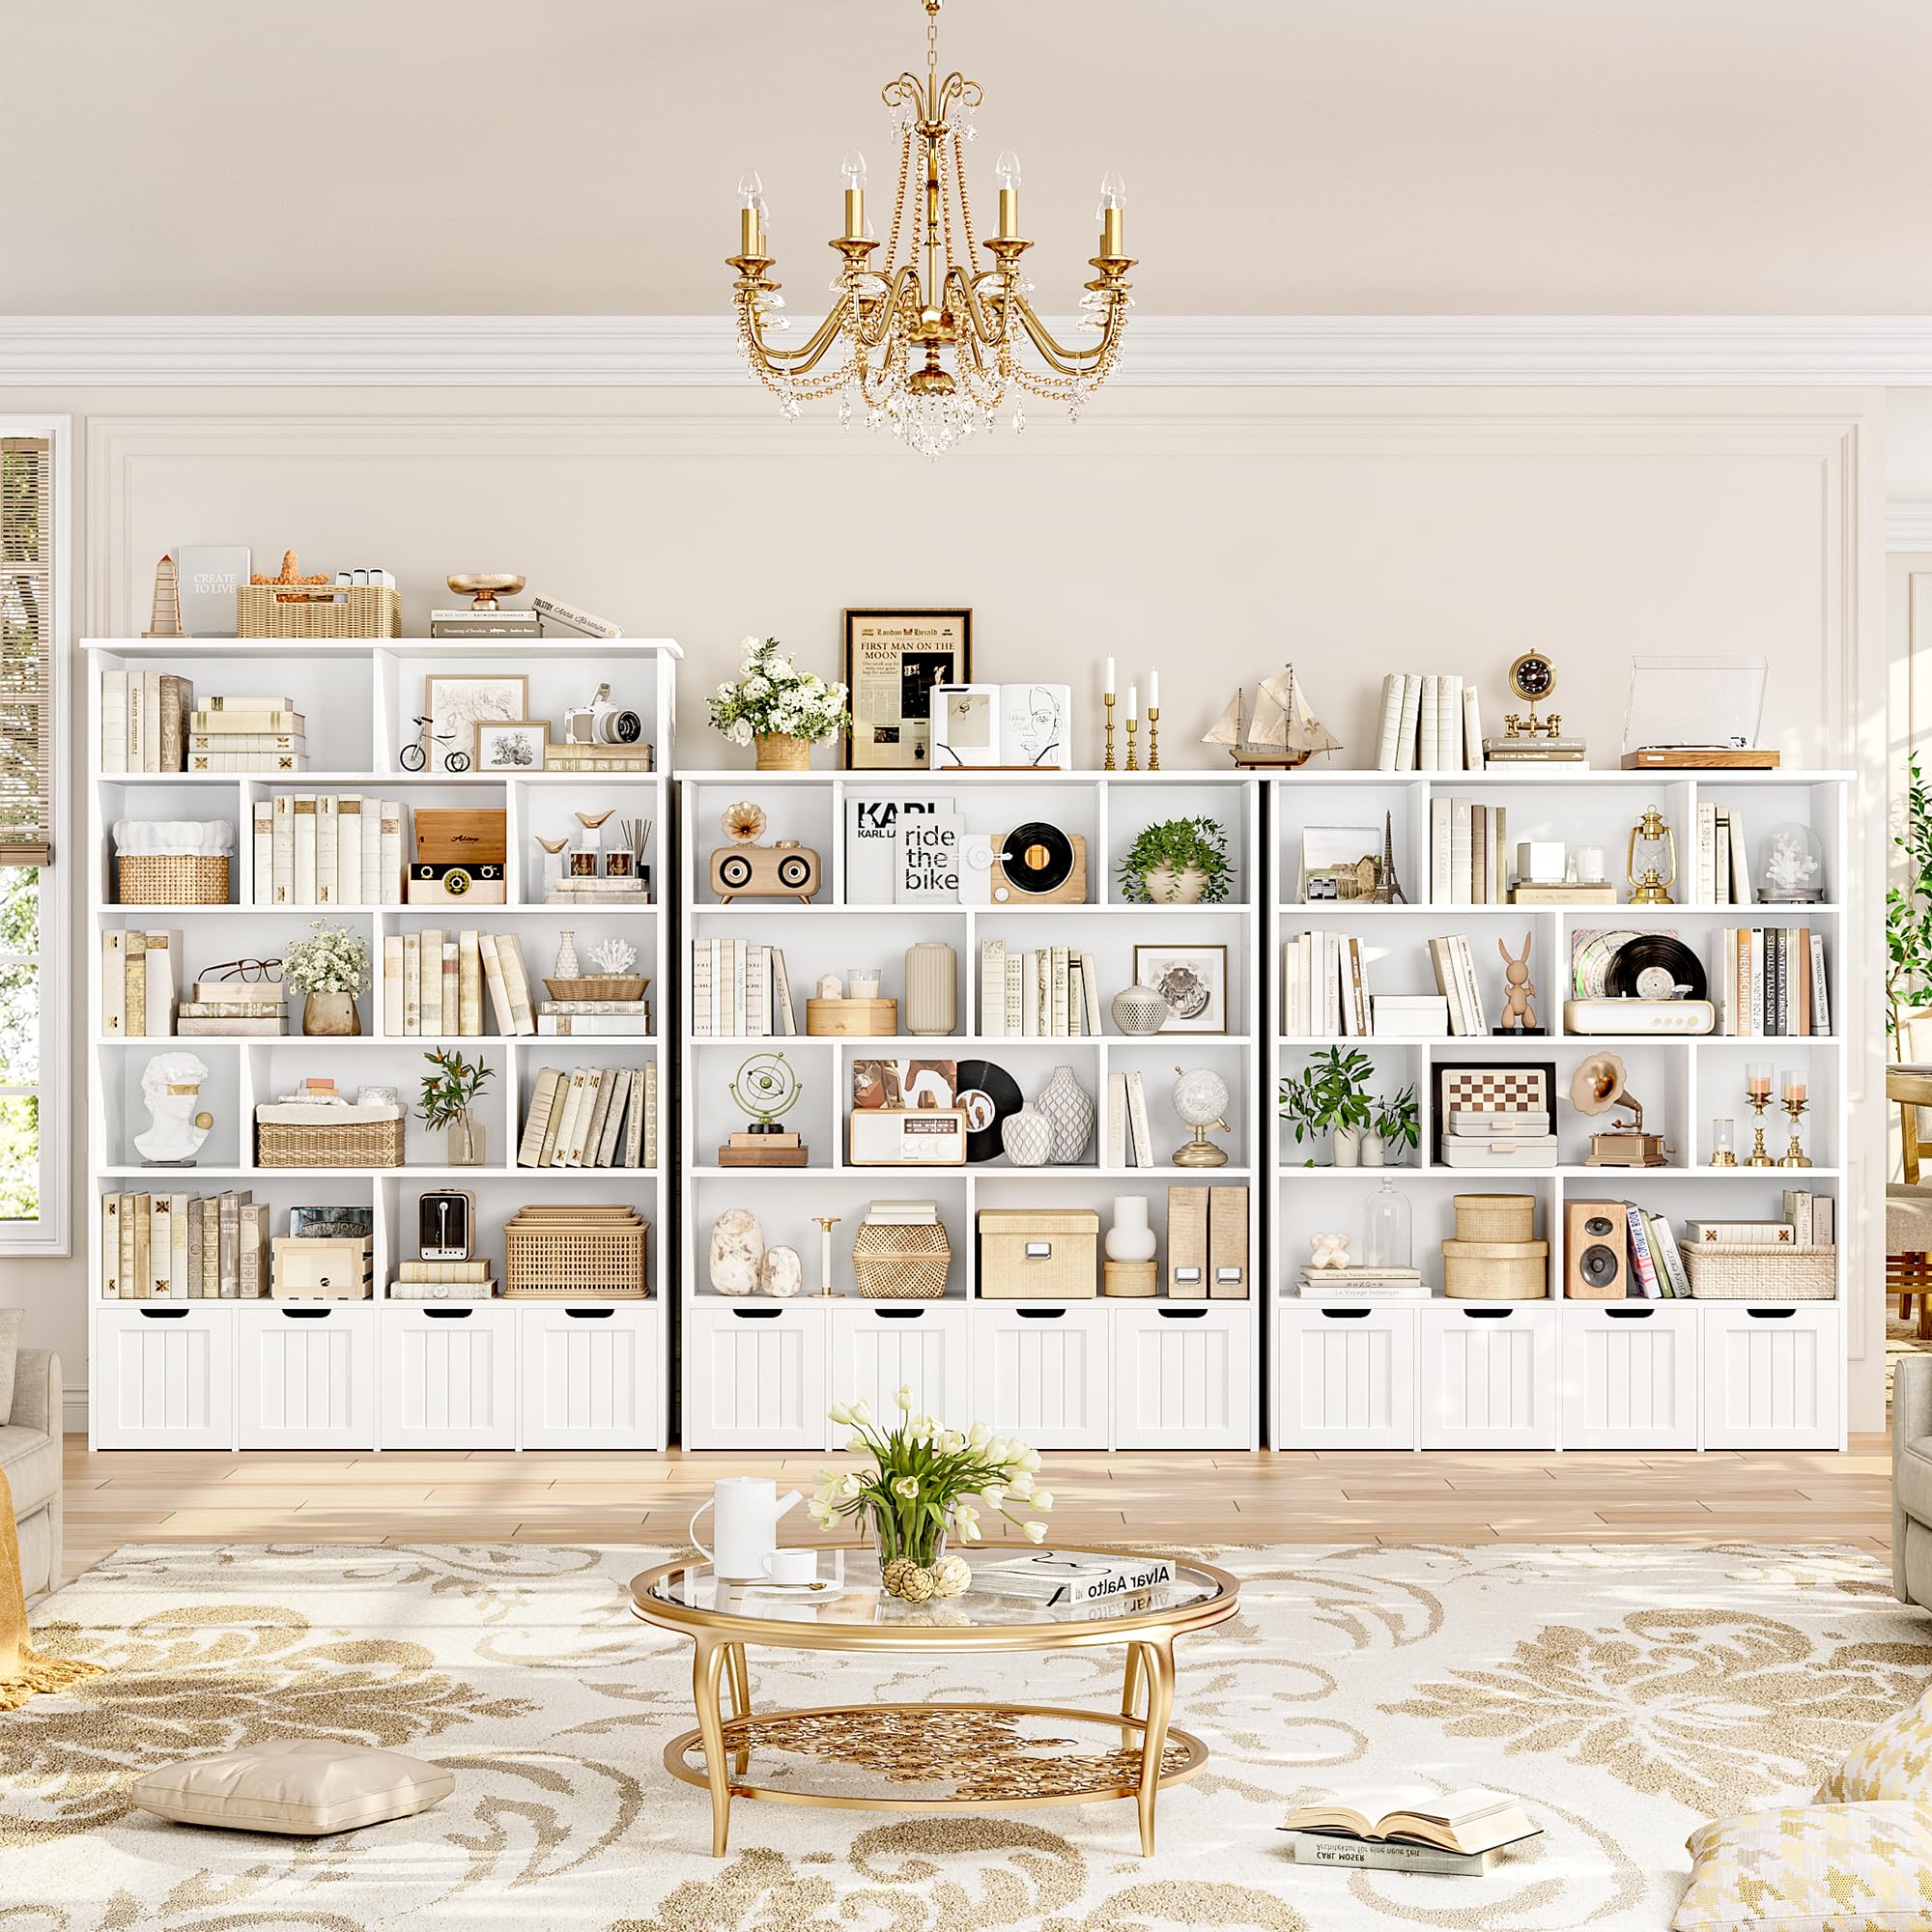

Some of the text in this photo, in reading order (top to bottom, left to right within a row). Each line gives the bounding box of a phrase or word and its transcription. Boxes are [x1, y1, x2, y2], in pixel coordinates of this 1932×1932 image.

[193, 573, 237, 583] CREATE
[193, 583, 236, 594] TO LIVE
[533, 597, 554, 611] TOLSTOY
[554, 607, 574, 619] Anna
[858, 830, 885, 838] KARL
[906, 825, 955, 846] ride
[906, 847, 948, 867] the
[906, 868, 958, 890] bike
[1739, 944, 1749, 1031] INNENARCHITEKTUR
